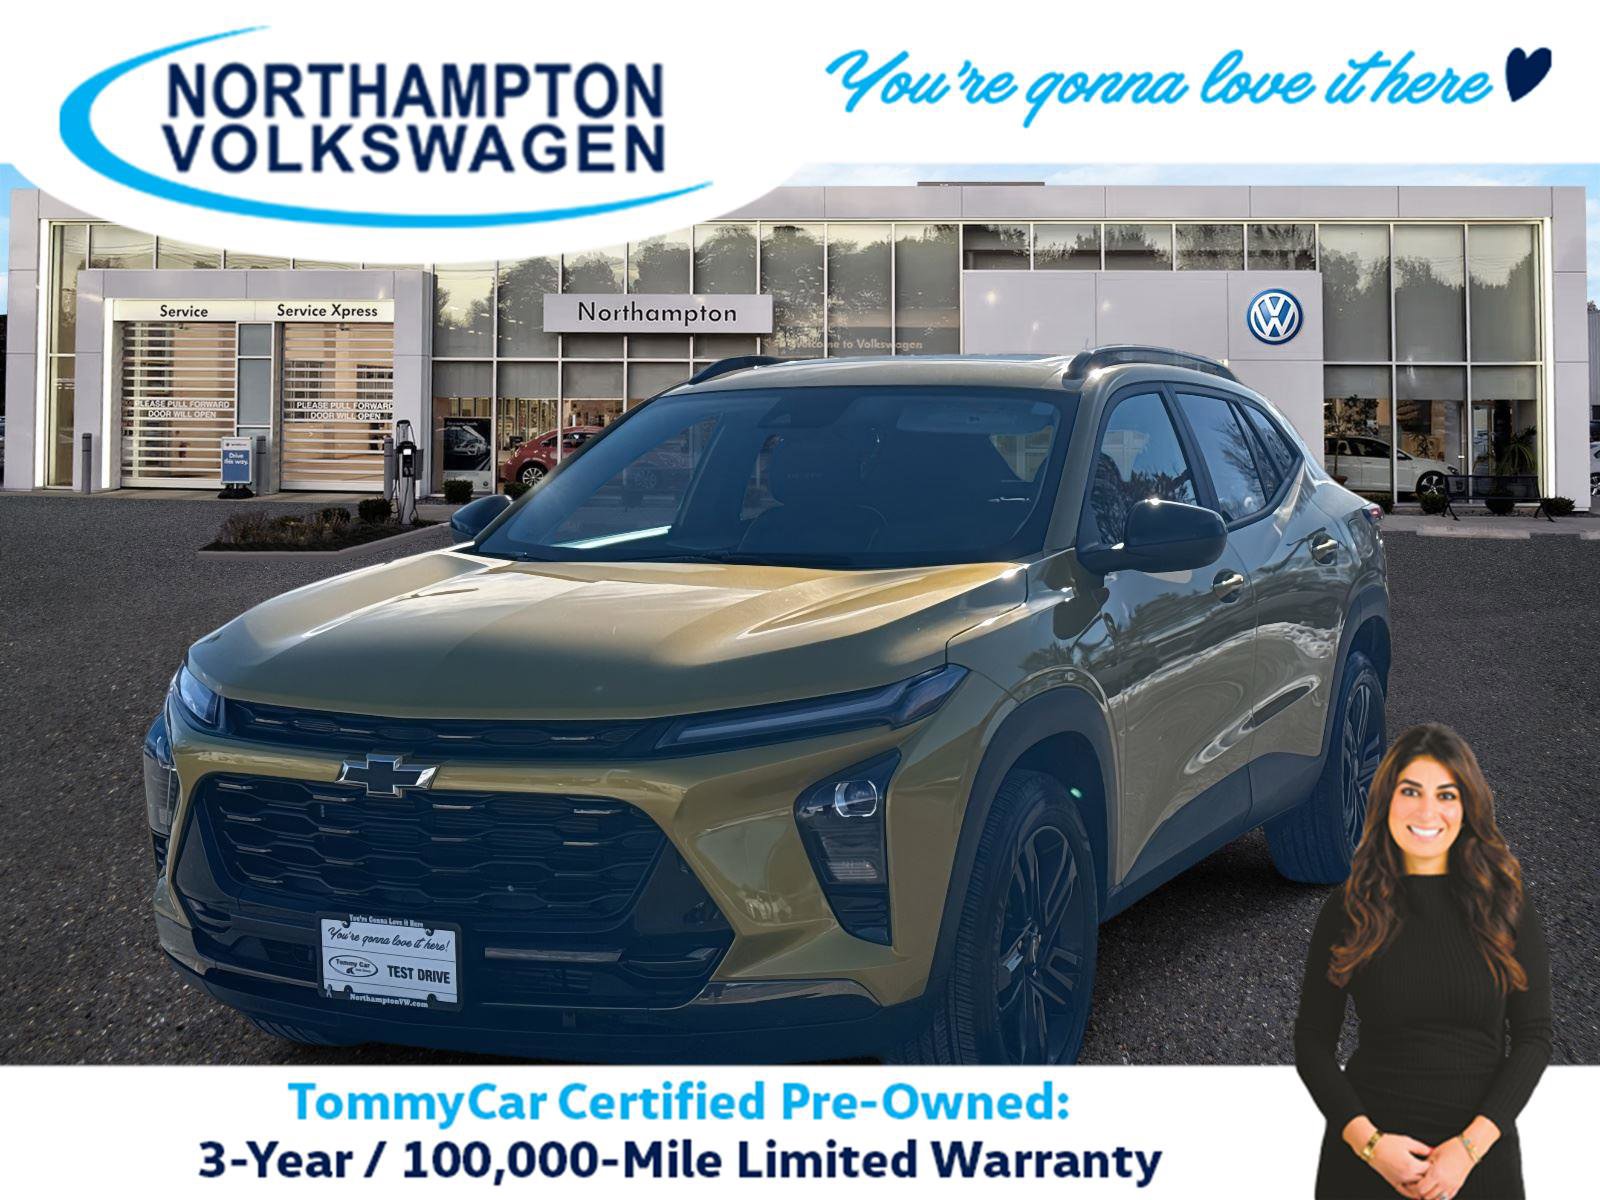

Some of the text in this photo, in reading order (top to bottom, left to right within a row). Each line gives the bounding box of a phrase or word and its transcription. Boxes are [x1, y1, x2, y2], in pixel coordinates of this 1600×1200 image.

[159, 305, 209, 318] Service
[277, 303, 378, 319] Service Xpress
[578, 301, 737, 327] Northampton
[842, 340, 853, 349] to
[856, 338, 923, 351] Volkswagen
[134, 400, 230, 409] PLEASE PULL FORWARD
[296, 401, 394, 410] PLEASE PULL FORWARD
[148, 410, 217, 418] DOOR WILL OPEN
[310, 412, 381, 420] DOOR WILL OPEN
[328, 927, 451, 952] You're gonna love it here!
[335, 958, 358, 968] Tommy
[386, 964, 451, 985] TEST DRIVE
[350, 993, 429, 1008] NorthamptonVW.com
